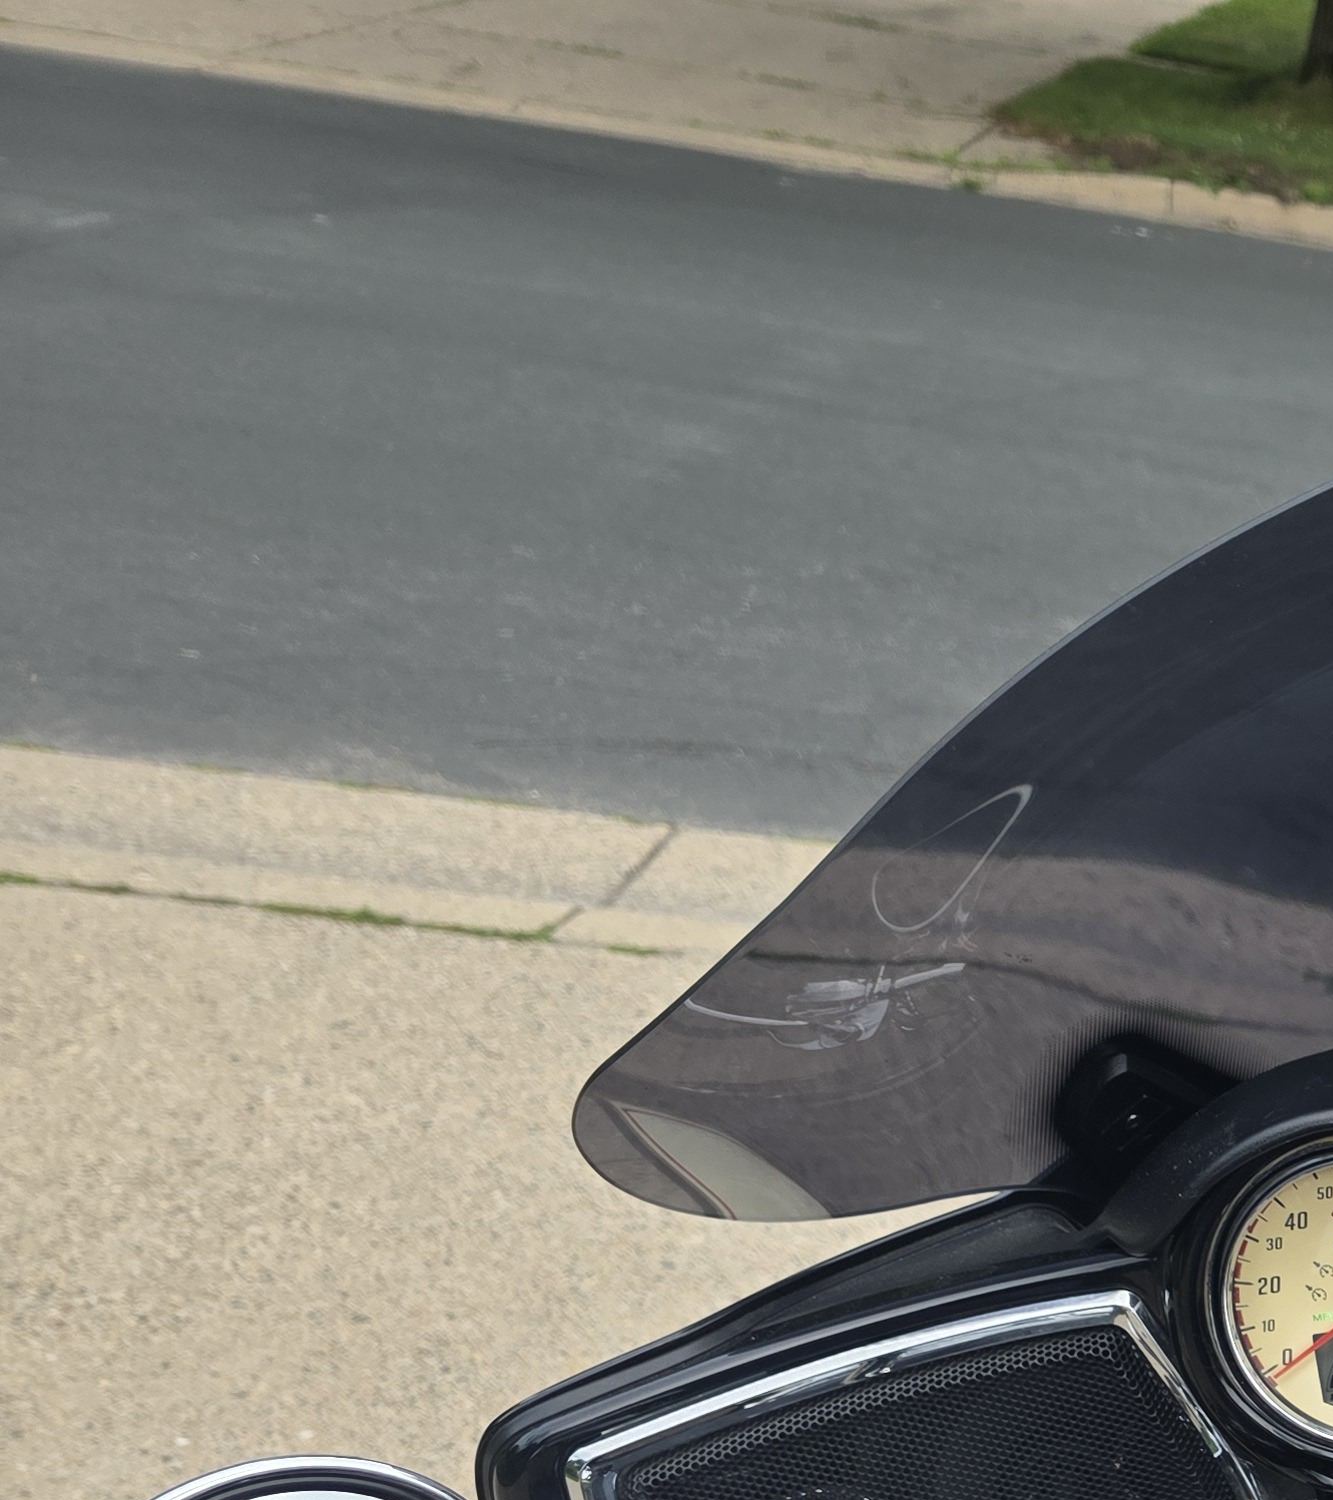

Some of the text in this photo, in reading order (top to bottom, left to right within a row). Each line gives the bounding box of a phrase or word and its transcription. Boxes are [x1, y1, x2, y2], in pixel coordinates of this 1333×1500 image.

[1317, 1186, 1333, 1200] 50
[1285, 1211, 1308, 1231] 40
[1266, 1237, 1283, 1251] 30
[1258, 1276, 1281, 1295] 20
[1262, 1319, 1275, 1332] 10
[1282, 1348, 1292, 1365] 0
